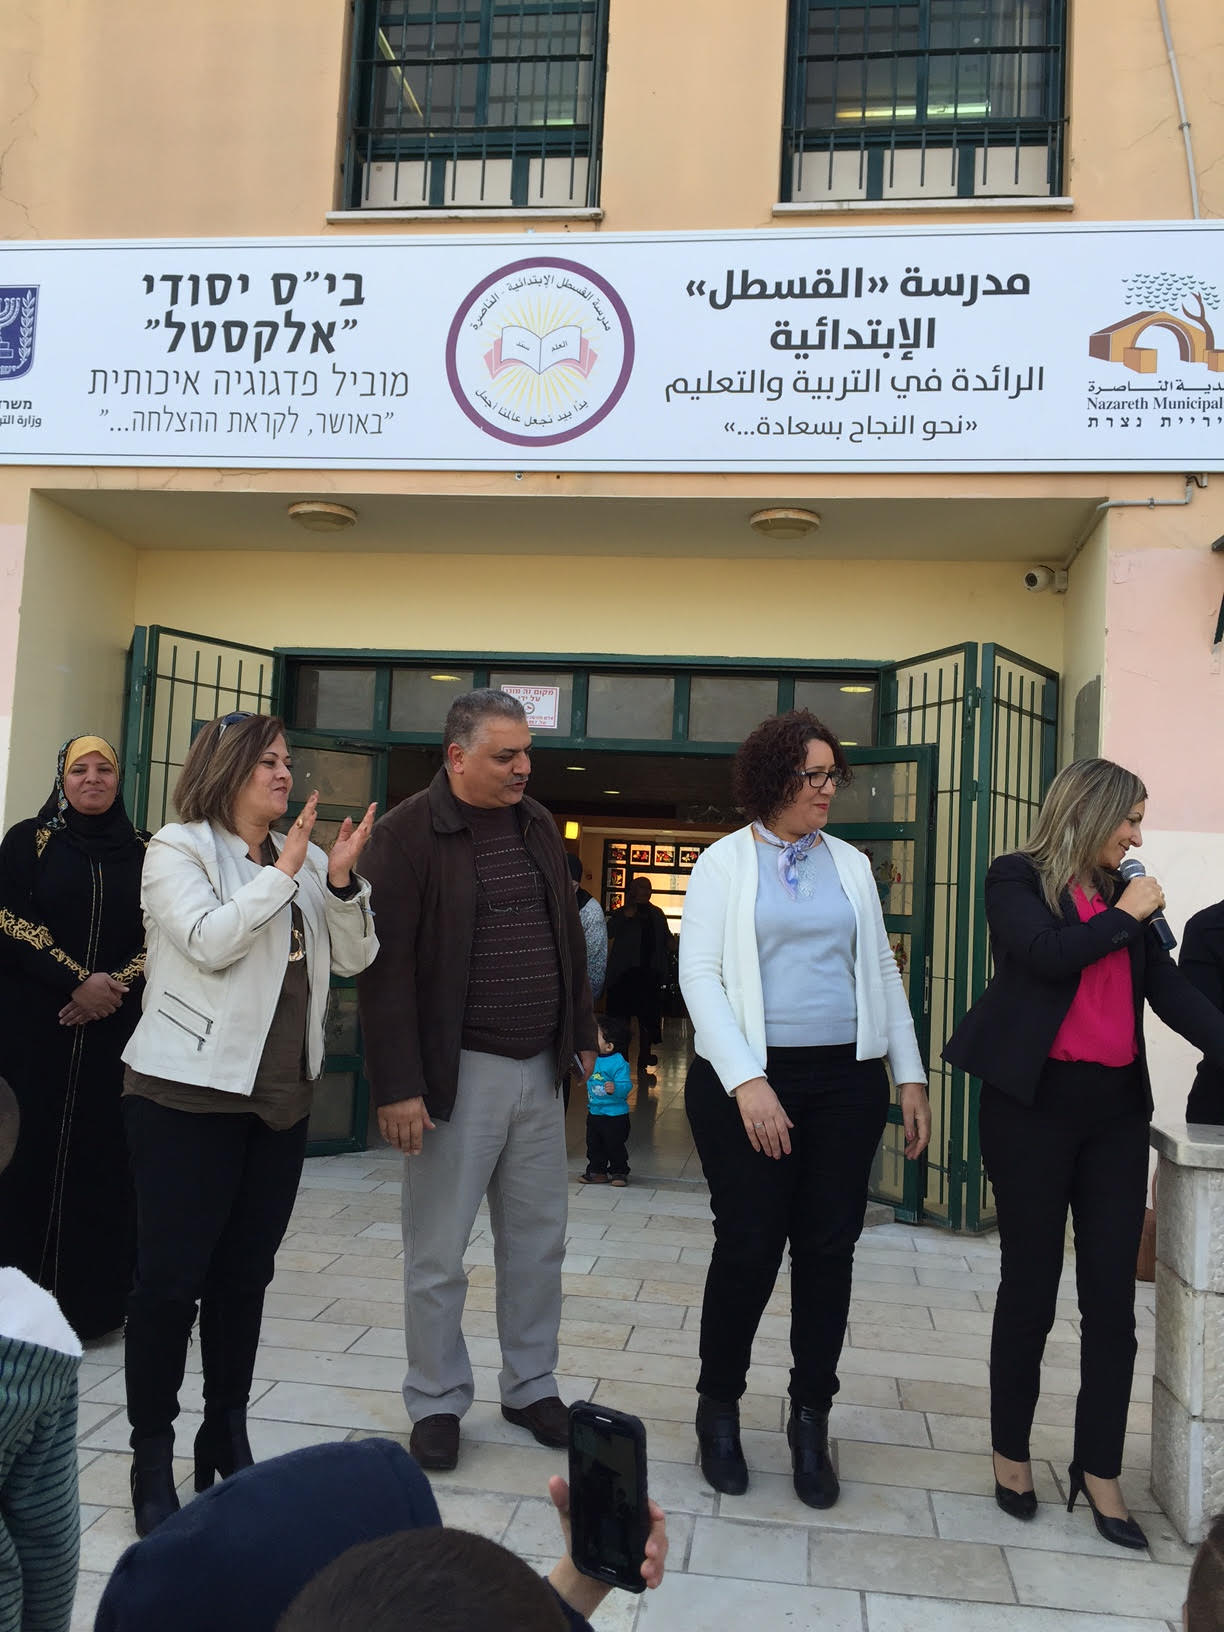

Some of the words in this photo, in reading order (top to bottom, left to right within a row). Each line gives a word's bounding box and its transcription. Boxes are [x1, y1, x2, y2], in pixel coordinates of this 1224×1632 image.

[142, 272, 250, 308] יסודי
[271, 271, 366, 307] בי"ס
[556, 274, 592, 302] القسطل
[685, 266, 889, 311] «القسطل»
[899, 266, 1031, 307] مدرسة
[470, 293, 499, 331] الناصرة
[592, 297, 611, 332] مدرسة
[769, 315, 936, 361] الإبتدائية
[87, 368, 200, 396] איכותית
[214, 369, 318, 397] פדגוגיה
[332, 362, 409, 397] מוביל
[665, 369, 784, 403] والتعليم
[792, 368, 881, 402] التربية
[890, 367, 943, 400] في
[951, 364, 1044, 400] الرائدة
[1087, 380, 1173, 395] الناصرة
[0, 400, 32, 410] משר
[1087, 397, 1149, 410] Nazareth
[1153, 396, 1223, 412] Municipal
[17, 415, 42, 428] وزارة
[226, 405, 299, 440] לקראת
[848, 414, 915, 444] النجاح
[922, 414, 978, 441] «نحو
[1087, 416, 1143, 428] נצרת
